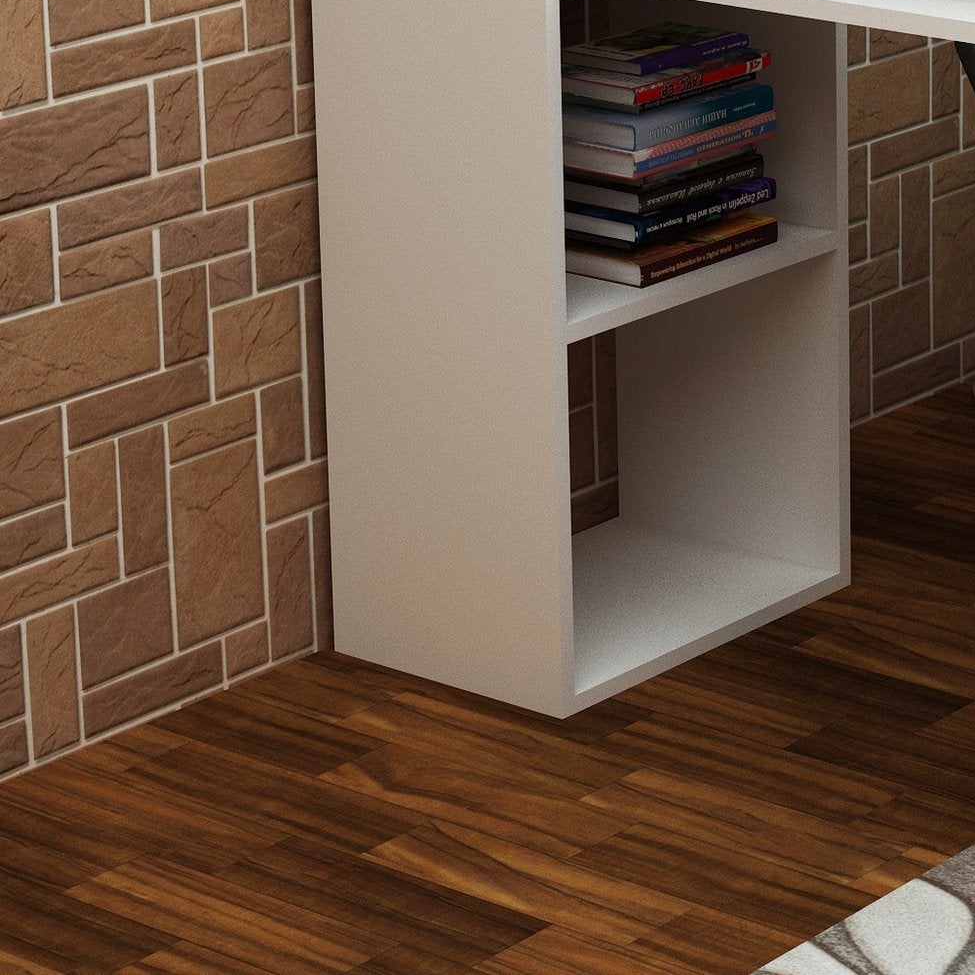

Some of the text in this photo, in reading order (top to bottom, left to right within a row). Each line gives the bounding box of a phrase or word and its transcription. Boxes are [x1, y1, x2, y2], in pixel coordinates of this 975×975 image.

[661, 73, 703, 96] FARC-EP
[649, 108, 728, 140] НАШИ АВИАНОСЦЫ
[696, 134, 742, 152] GENERATION
[725, 167, 757, 182] Записки
[688, 179, 716, 196] берегов
[756, 188, 769, 201] Led
[728, 193, 756, 209] Zeppelin
[697, 208, 708, 219] and
[708, 204, 722, 216] Rock
[663, 216, 683, 228] История
[686, 212, 697, 223] Roll
[645, 224, 659, 233] песни
